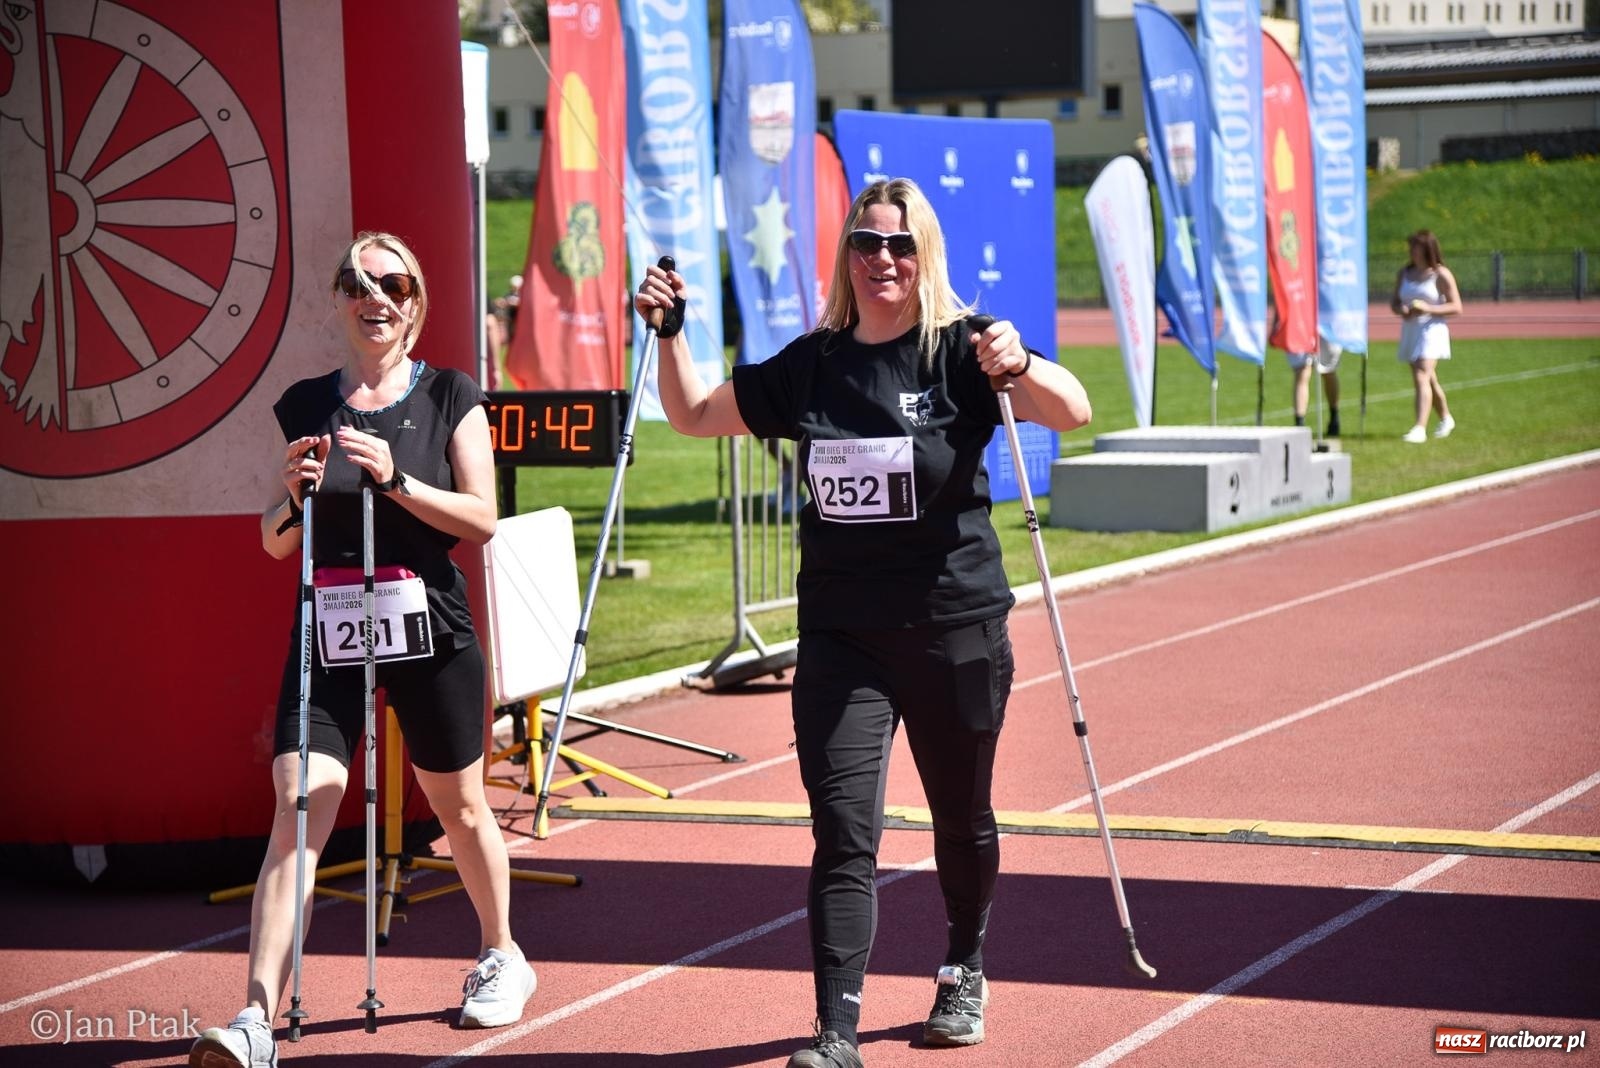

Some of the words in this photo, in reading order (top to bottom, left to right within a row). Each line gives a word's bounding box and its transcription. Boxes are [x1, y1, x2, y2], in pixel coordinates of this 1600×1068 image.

[826, 445, 841, 455] BIEG
[842, 445, 856, 455] BEZ
[857, 443, 887, 454] GRANIC
[1283, 441, 1290, 484] 1
[821, 475, 881, 507] 252
[1326, 467, 1335, 500] 3
[322, 592, 339, 602] XVIII
[340, 591, 357, 601] BIEG
